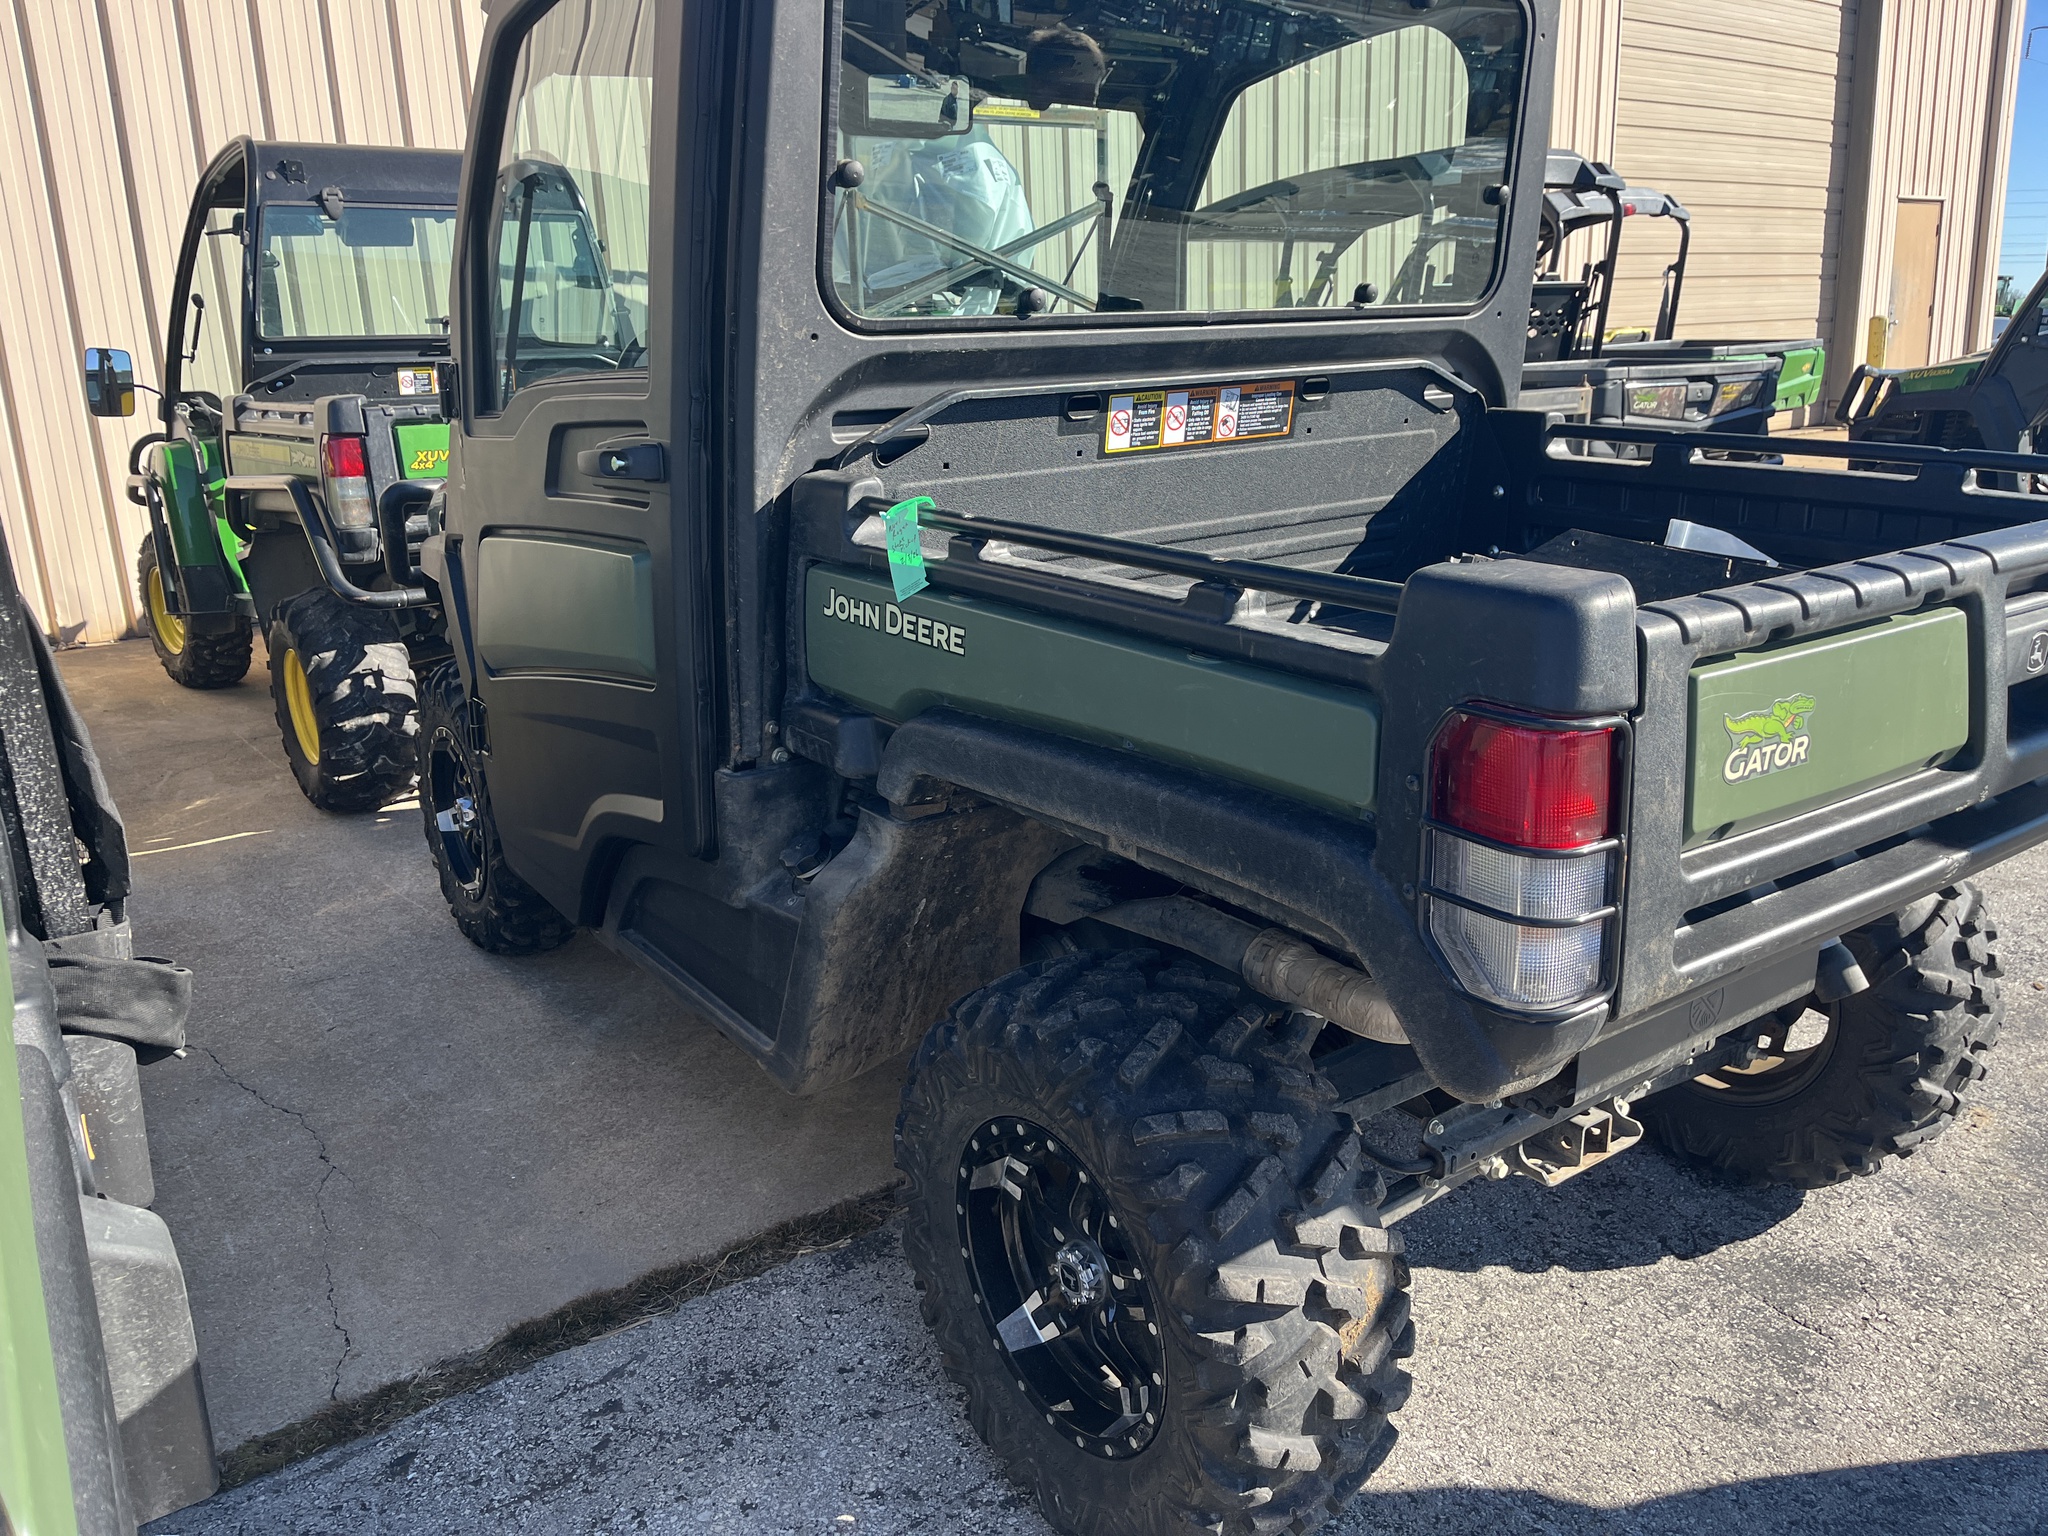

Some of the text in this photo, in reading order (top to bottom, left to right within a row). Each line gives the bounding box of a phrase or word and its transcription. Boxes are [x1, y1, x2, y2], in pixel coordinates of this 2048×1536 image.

[1142, 393, 1162, 401] CAUTION
[1633, 400, 1658, 411] GATOR
[416, 450, 450, 463] XUV
[410, 461, 434, 471] 4x4
[823, 586, 966, 657] JOHN DEERE
[1723, 733, 1810, 783] GATOR
